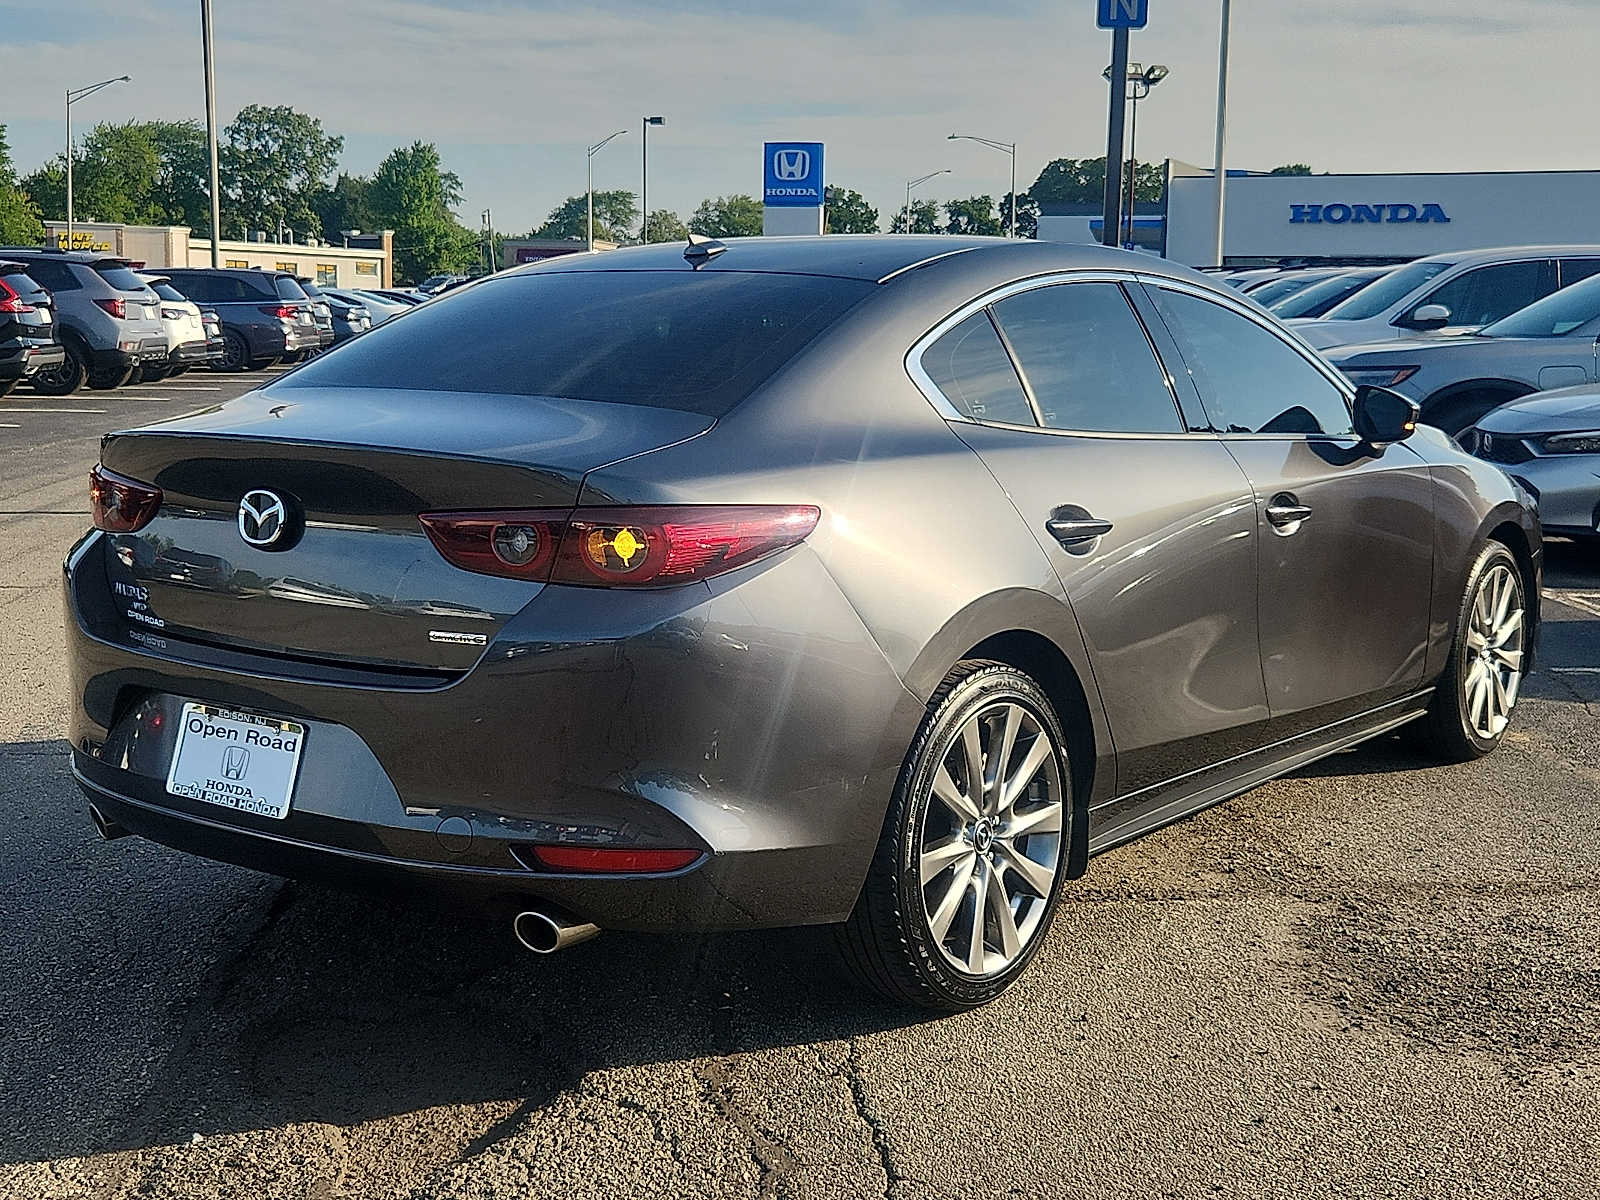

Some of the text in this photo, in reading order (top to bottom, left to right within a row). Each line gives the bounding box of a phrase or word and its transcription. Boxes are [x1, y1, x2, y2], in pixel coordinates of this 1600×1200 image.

[766, 188, 818, 196] HONDA
[1289, 203, 1451, 224] HONDA
[57, 231, 94, 241] TNT
[145, 615, 165, 627] ROAD
[254, 717, 267, 725] NJ
[188, 718, 298, 753] Open Road
[205, 779, 254, 798] HONDA
[173, 784, 280, 817] OPEN ROAD HONDA
